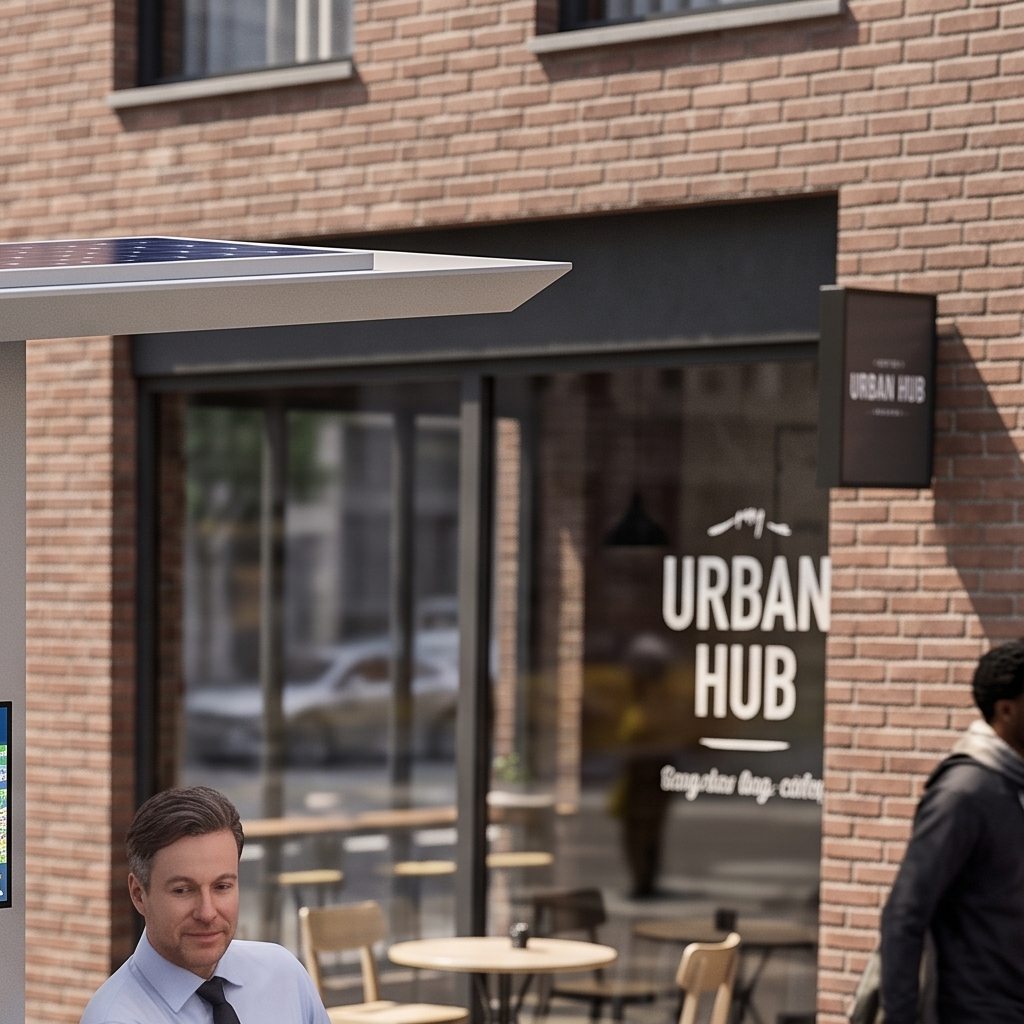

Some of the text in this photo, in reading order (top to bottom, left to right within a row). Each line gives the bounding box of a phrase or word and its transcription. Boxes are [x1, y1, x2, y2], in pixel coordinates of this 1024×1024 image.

[849, 371, 926, 404] URBAN HUB
[662, 555, 831, 632] URBAN
[694, 643, 797, 720] HUB
